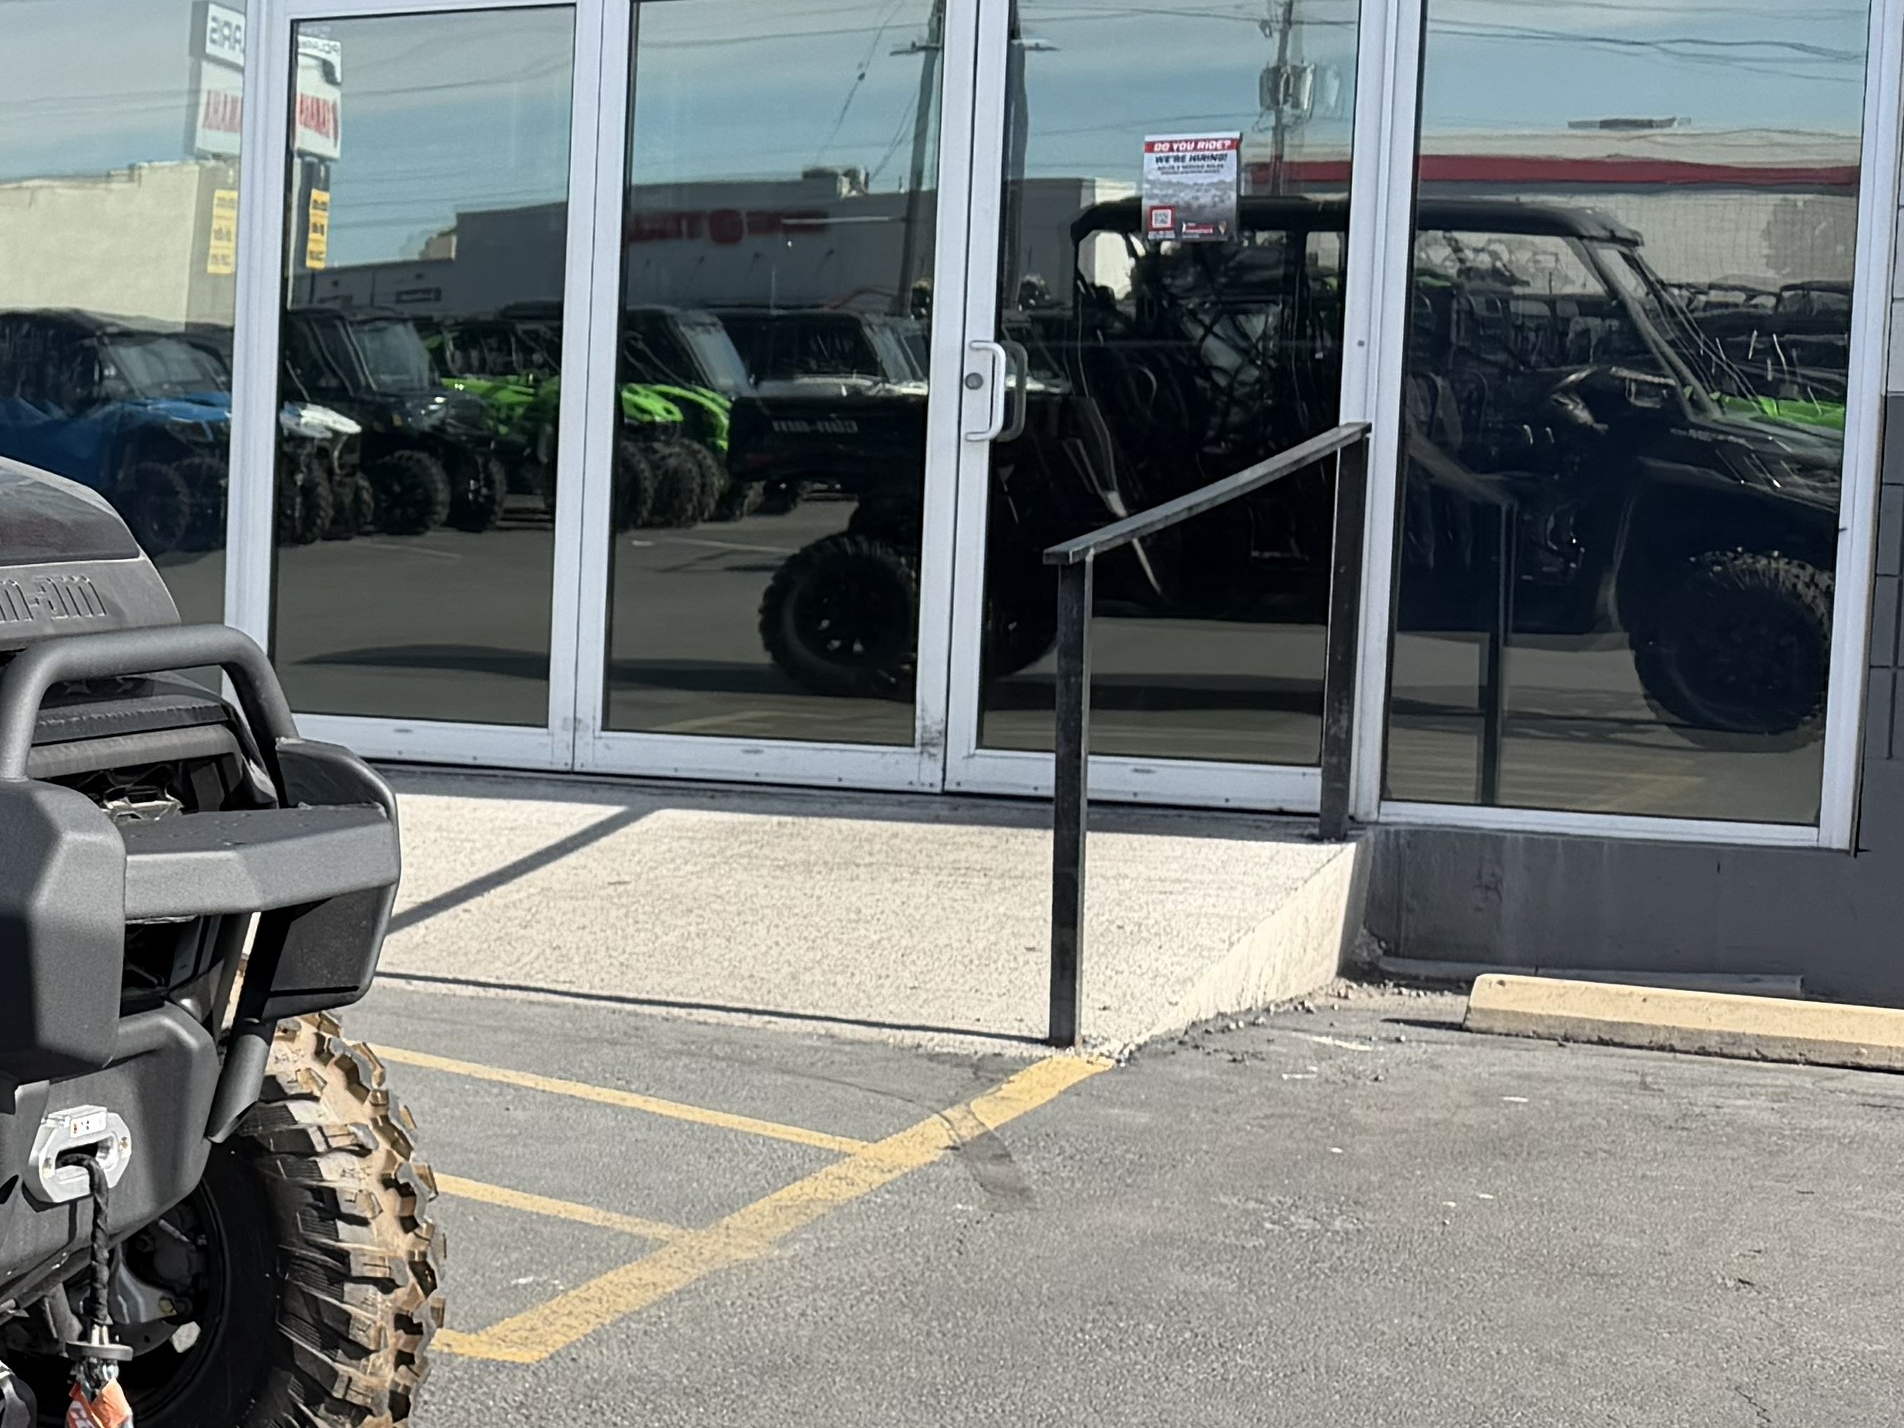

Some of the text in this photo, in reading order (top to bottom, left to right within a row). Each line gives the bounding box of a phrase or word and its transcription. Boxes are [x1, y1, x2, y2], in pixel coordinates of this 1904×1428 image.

[1154, 139, 1232, 152] DO YOU RIDE?
